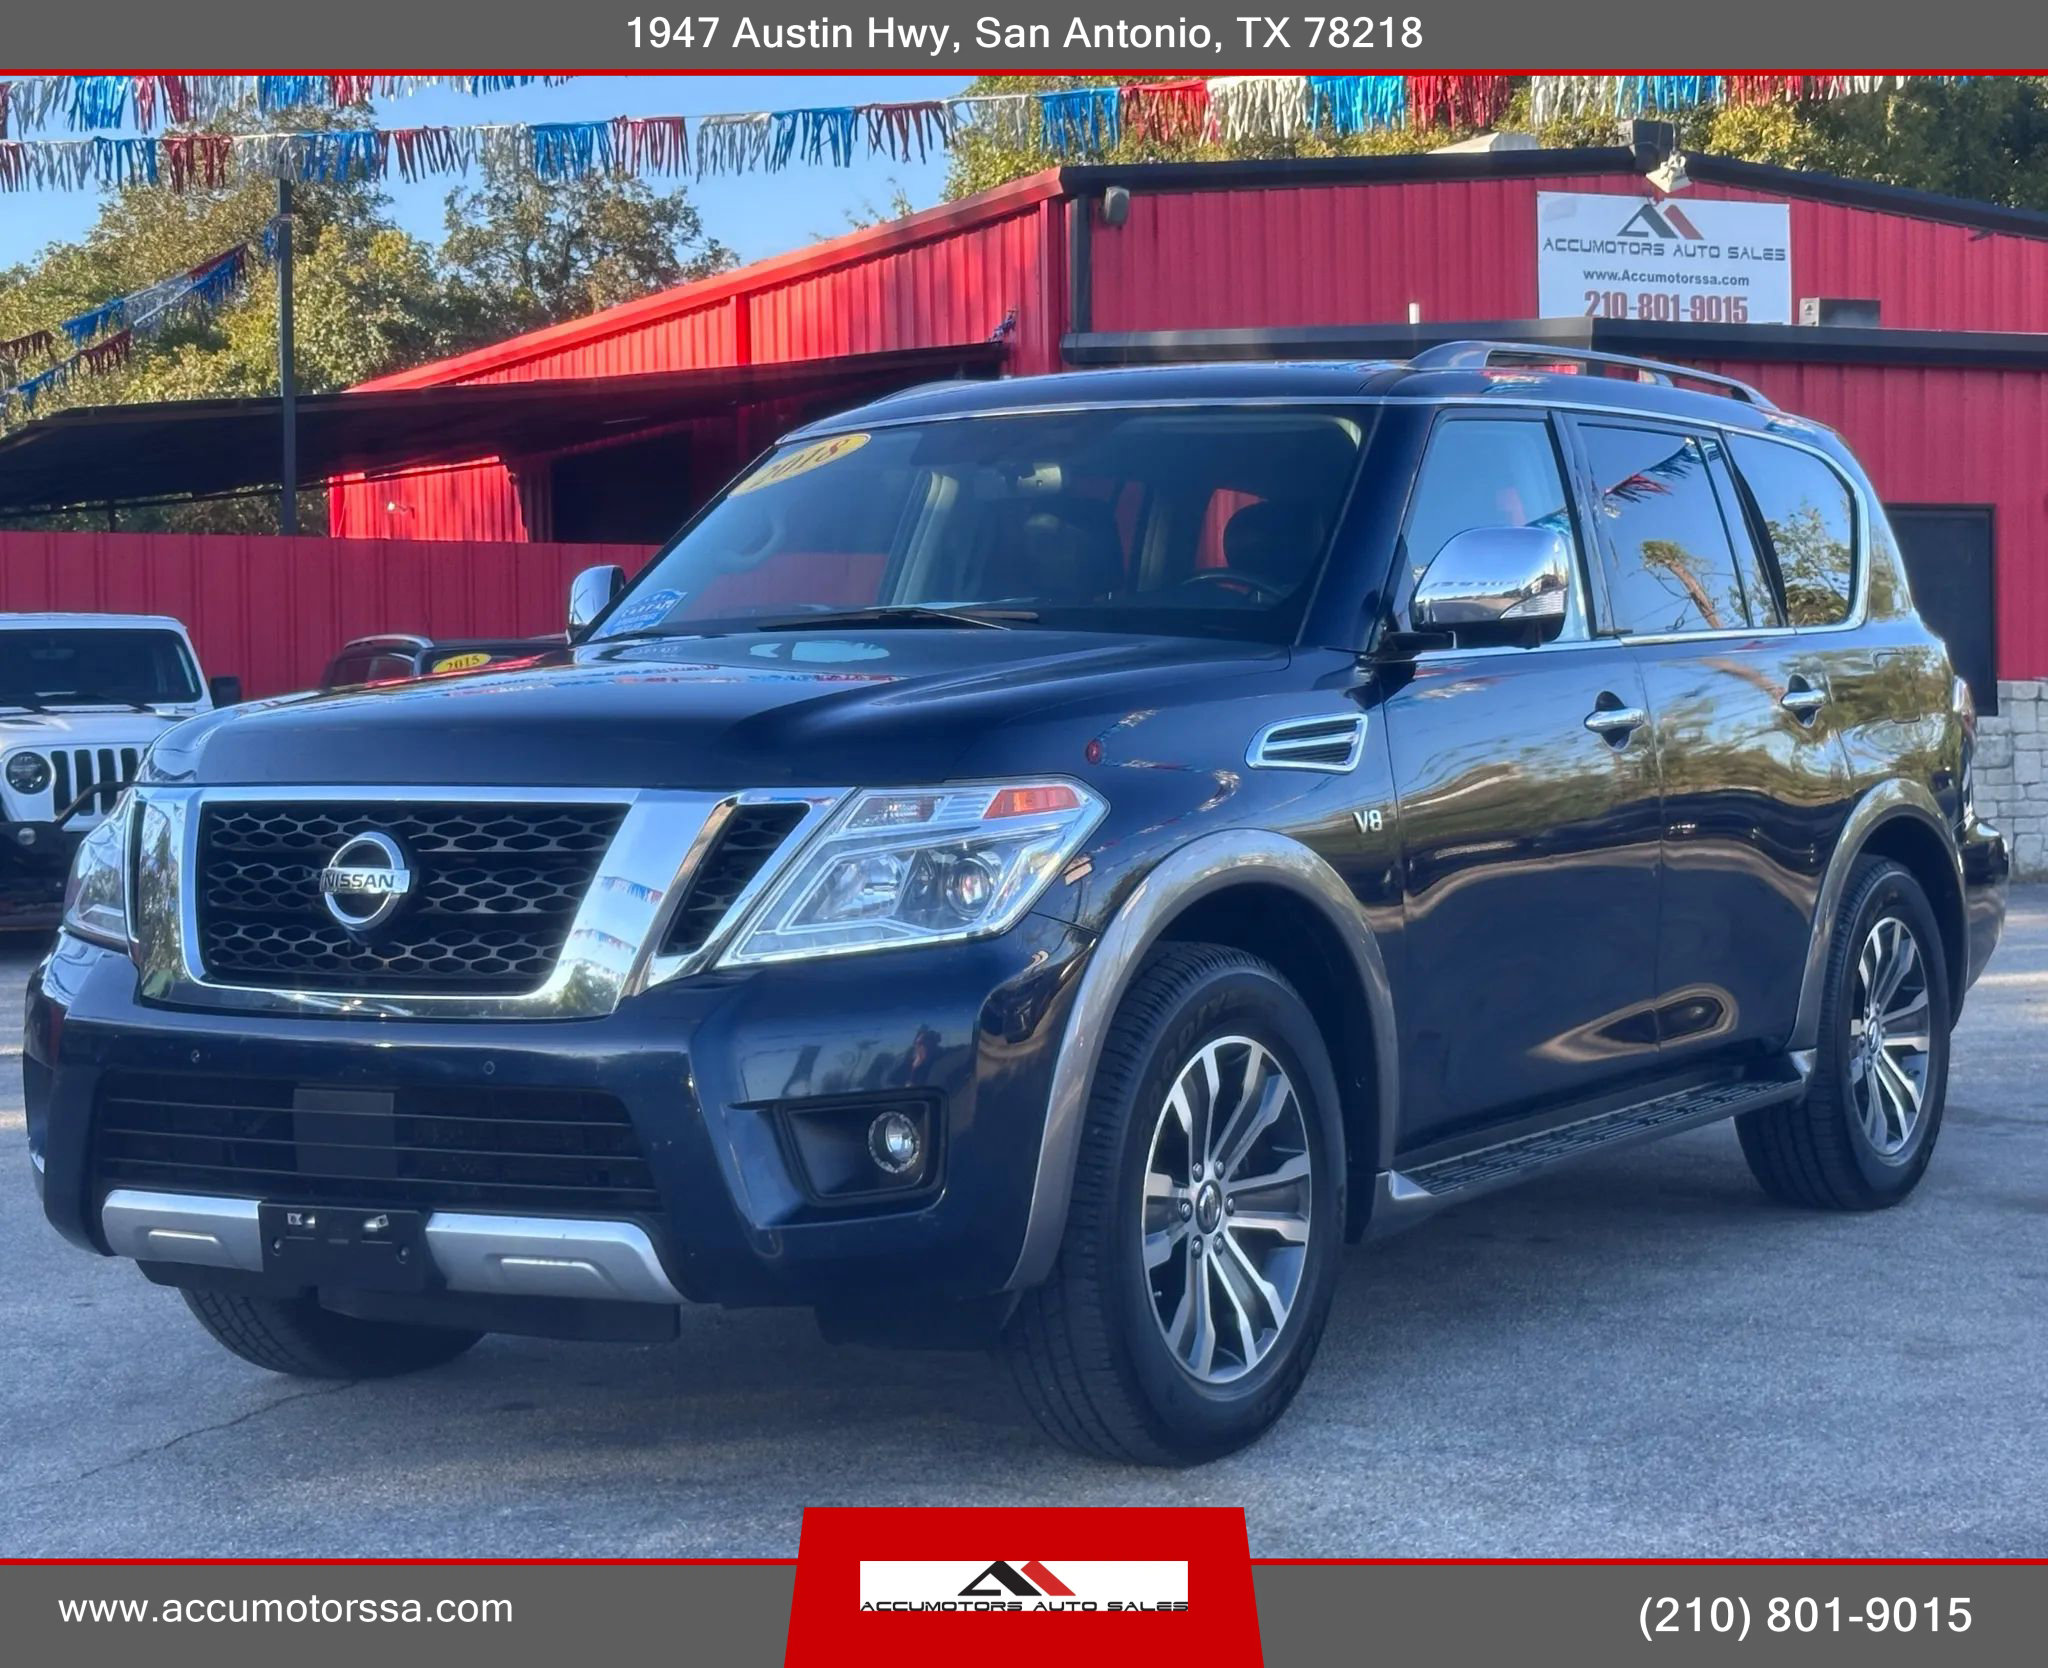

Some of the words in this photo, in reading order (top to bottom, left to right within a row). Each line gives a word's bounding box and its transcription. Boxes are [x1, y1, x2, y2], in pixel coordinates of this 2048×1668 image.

[1543, 238, 1665, 257] ACCUMOTORS
[1673, 244, 1720, 259] AUTO
[1728, 247, 1786, 261] SALES
[1583, 270, 1750, 286] www.Accumotorssa.com
[1584, 290, 1749, 324] 210-801-9015
[447, 656, 480, 669] 2015
[1352, 809, 1383, 833] V8
[323, 872, 395, 889] NISSAN
